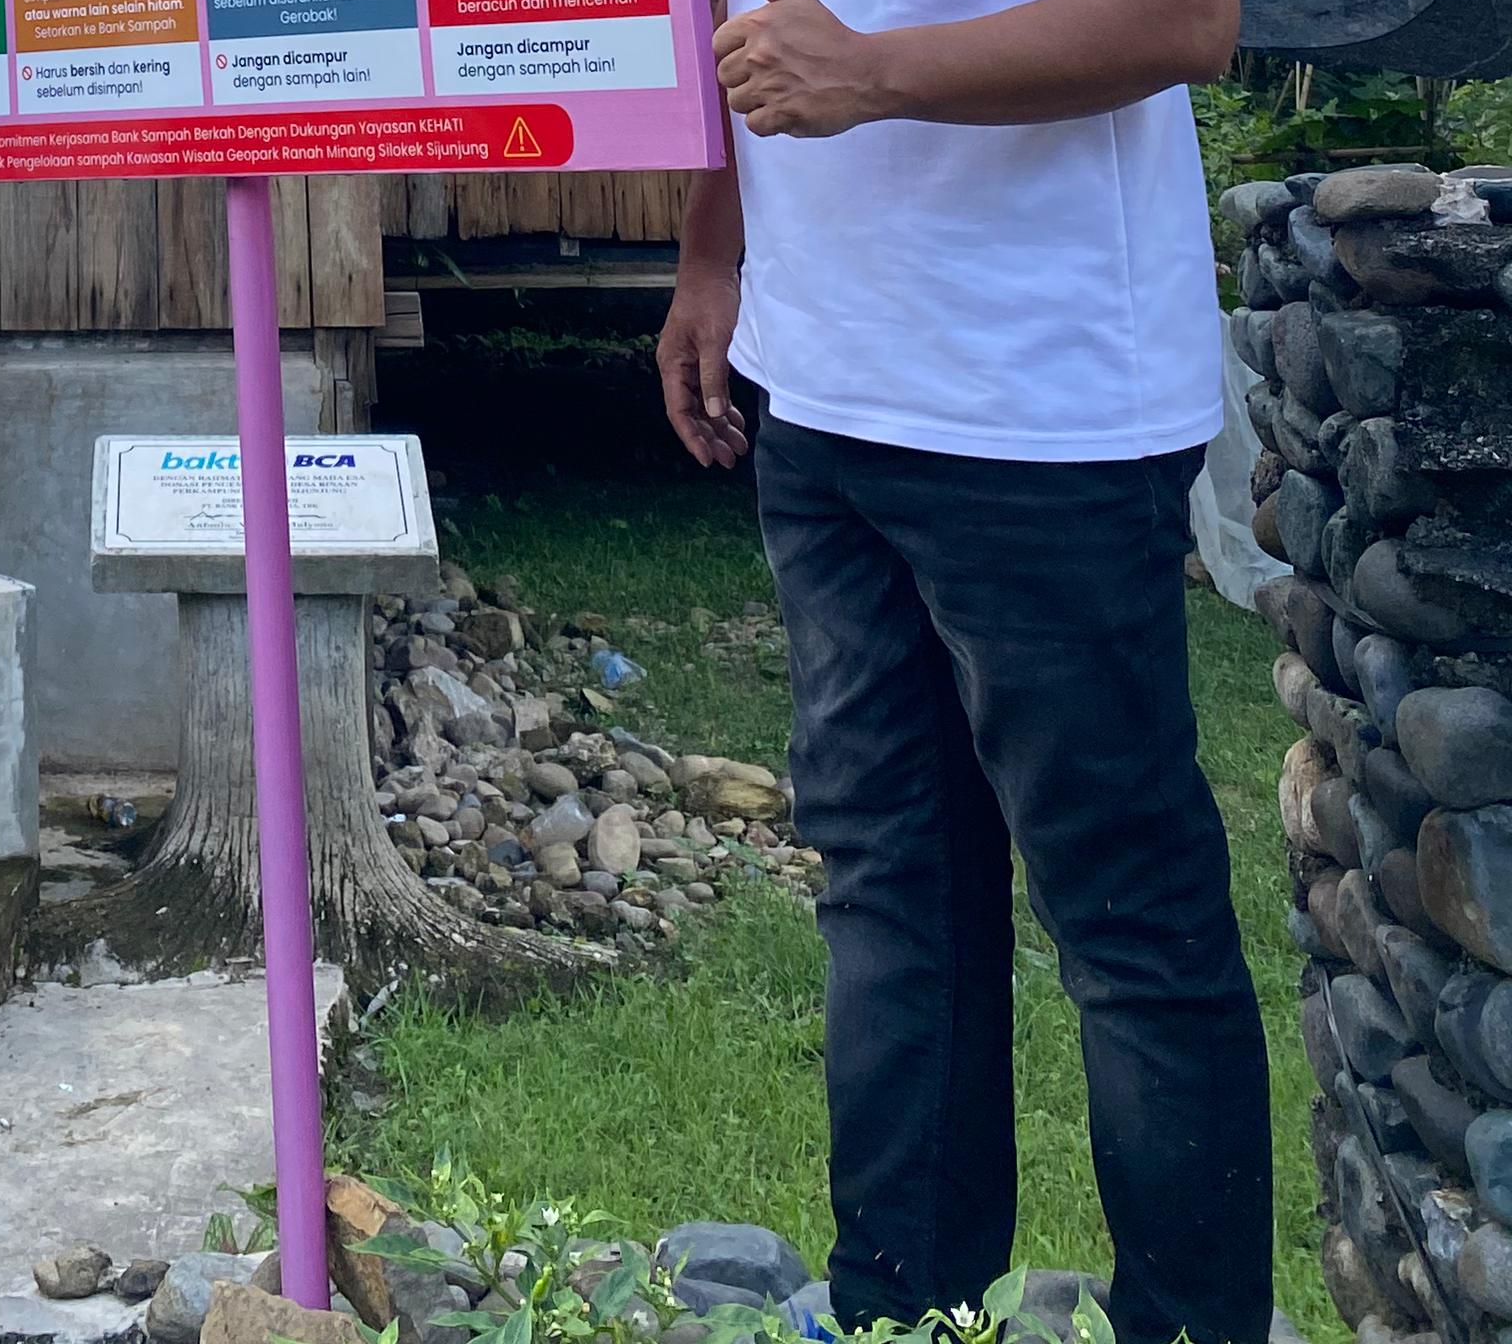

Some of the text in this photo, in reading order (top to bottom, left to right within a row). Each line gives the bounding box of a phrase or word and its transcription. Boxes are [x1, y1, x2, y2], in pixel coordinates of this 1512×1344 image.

[24, 8, 50, 21] atau
[52, 5, 87, 18] warna
[89, 2, 110, 16] lain
[112, 0, 145, 14] selain
[280, 8, 337, 24] Gerobak!
[35, 17, 176, 39] Setorkan ke Bank Sampah
[457, 38, 590, 59] Jangan dicampur
[36, 59, 170, 79] Harus bersih dan kering
[232, 50, 348, 70] Jangan dicampur
[458, 57, 615, 81] dengan sampah lain!
[37, 81, 142, 98] sebelum disimpan!
[233, 68, 371, 91] dengan sampah lain!
[49, 133, 110, 149] Kerjasama
[111, 129, 139, 144] Bank
[141, 128, 191, 145] Sampah
[193, 127, 236, 141] Berkah
[239, 124, 288, 143] Dengan
[290, 122, 357, 140] Dukungan
[359, 121, 417, 138] Yayasan
[419, 118, 463, 132] KEHATI
[7, 154, 75, 172] Pengelolaan
[77, 152, 125, 168] sampah
[127, 150, 180, 165] Kawasan
[182, 149, 224, 163] Wisata
[227, 145, 280, 164] Geopark
[281, 145, 324, 159] Ranah
[326, 142, 376, 161] Minang
[378, 140, 423, 158] Silokek
[426, 141, 488, 159] Sijunjung
[161, 451, 356, 470] bakt BCA
